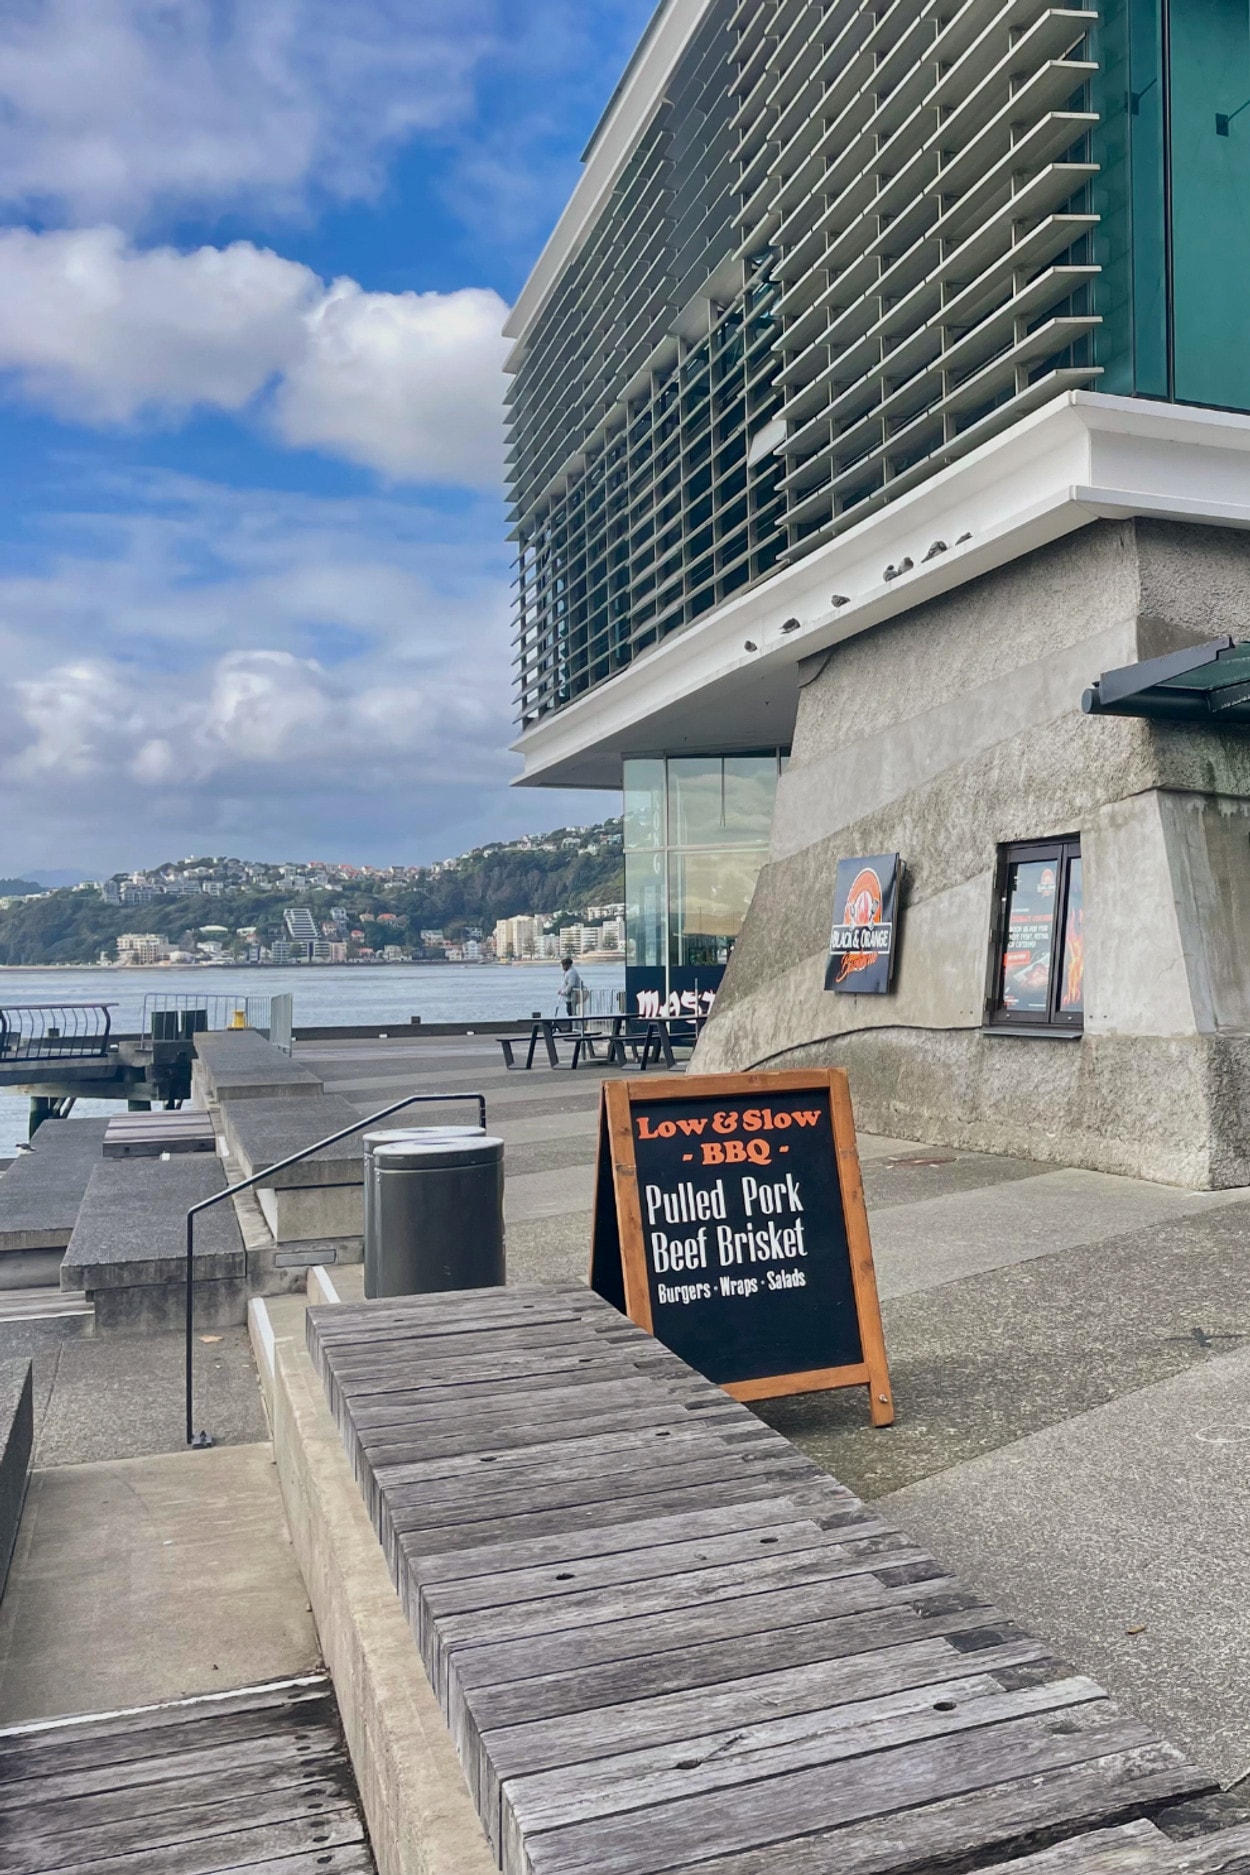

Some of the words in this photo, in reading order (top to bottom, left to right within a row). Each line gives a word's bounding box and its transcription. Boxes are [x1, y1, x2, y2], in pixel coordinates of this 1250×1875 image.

[832, 930, 853, 948] BLACK
[853, 929, 860, 949] &
[861, 929, 889, 948] ORANGE
[636, 1117, 708, 1140] Low
[712, 1111, 739, 1134] &
[742, 1109, 822, 1132] Slow
[701, 1138, 772, 1166] BBQ
[645, 1179, 727, 1225] Pulled
[741, 1173, 804, 1217] Pork
[651, 1227, 708, 1273] Beef
[716, 1217, 808, 1267] Brisket
[658, 1282, 712, 1305] Burgers
[719, 1276, 759, 1298] Wraps
[766, 1268, 807, 1291] Salads
